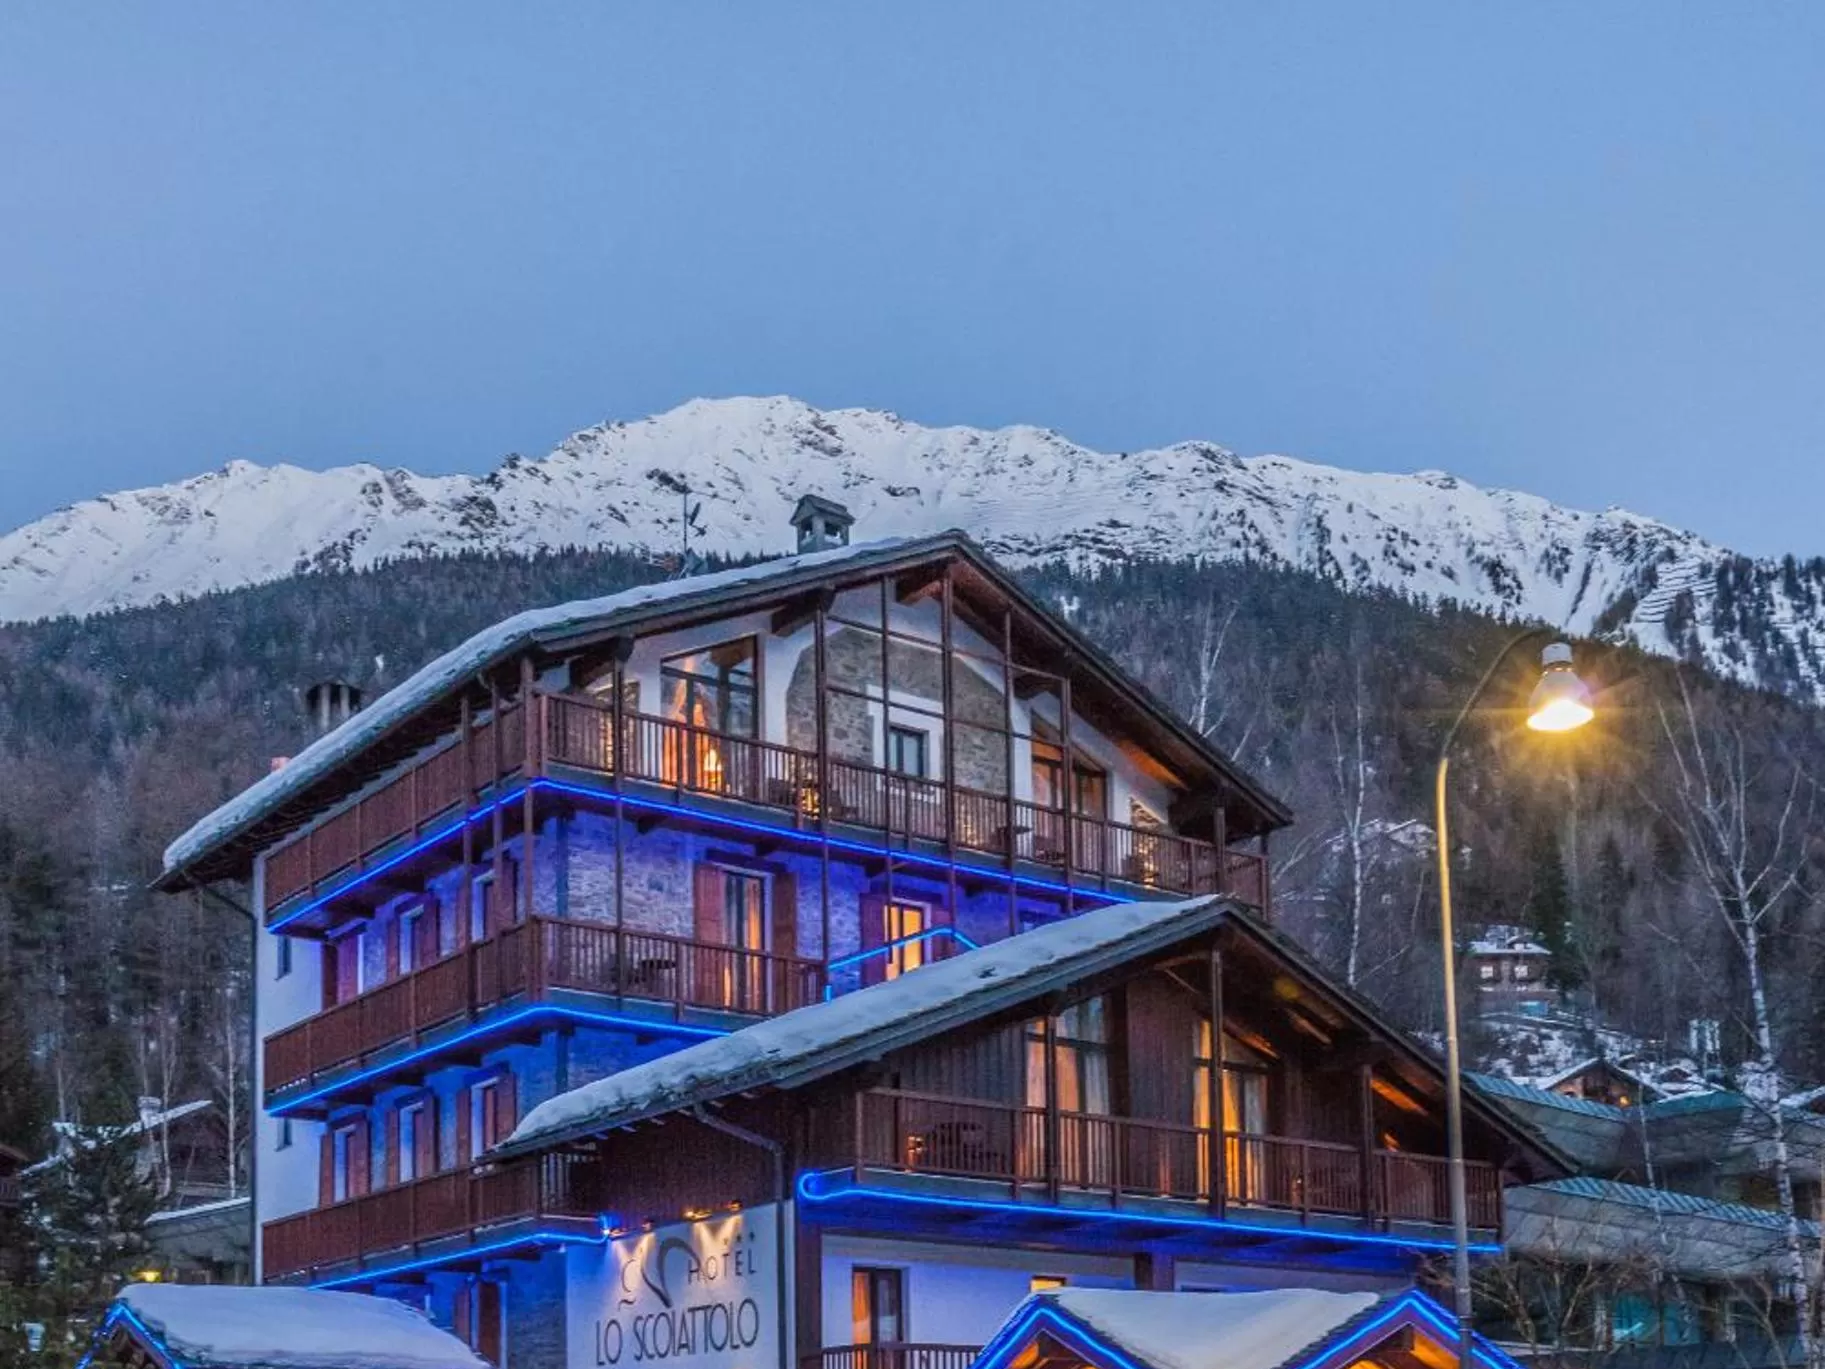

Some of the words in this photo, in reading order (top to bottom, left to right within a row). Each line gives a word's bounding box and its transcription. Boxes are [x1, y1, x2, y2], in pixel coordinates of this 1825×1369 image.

[687, 1250, 757, 1285] HOTEL
[596, 1318, 623, 1367] LO
[633, 1298, 760, 1362] SCOIATTOLO
